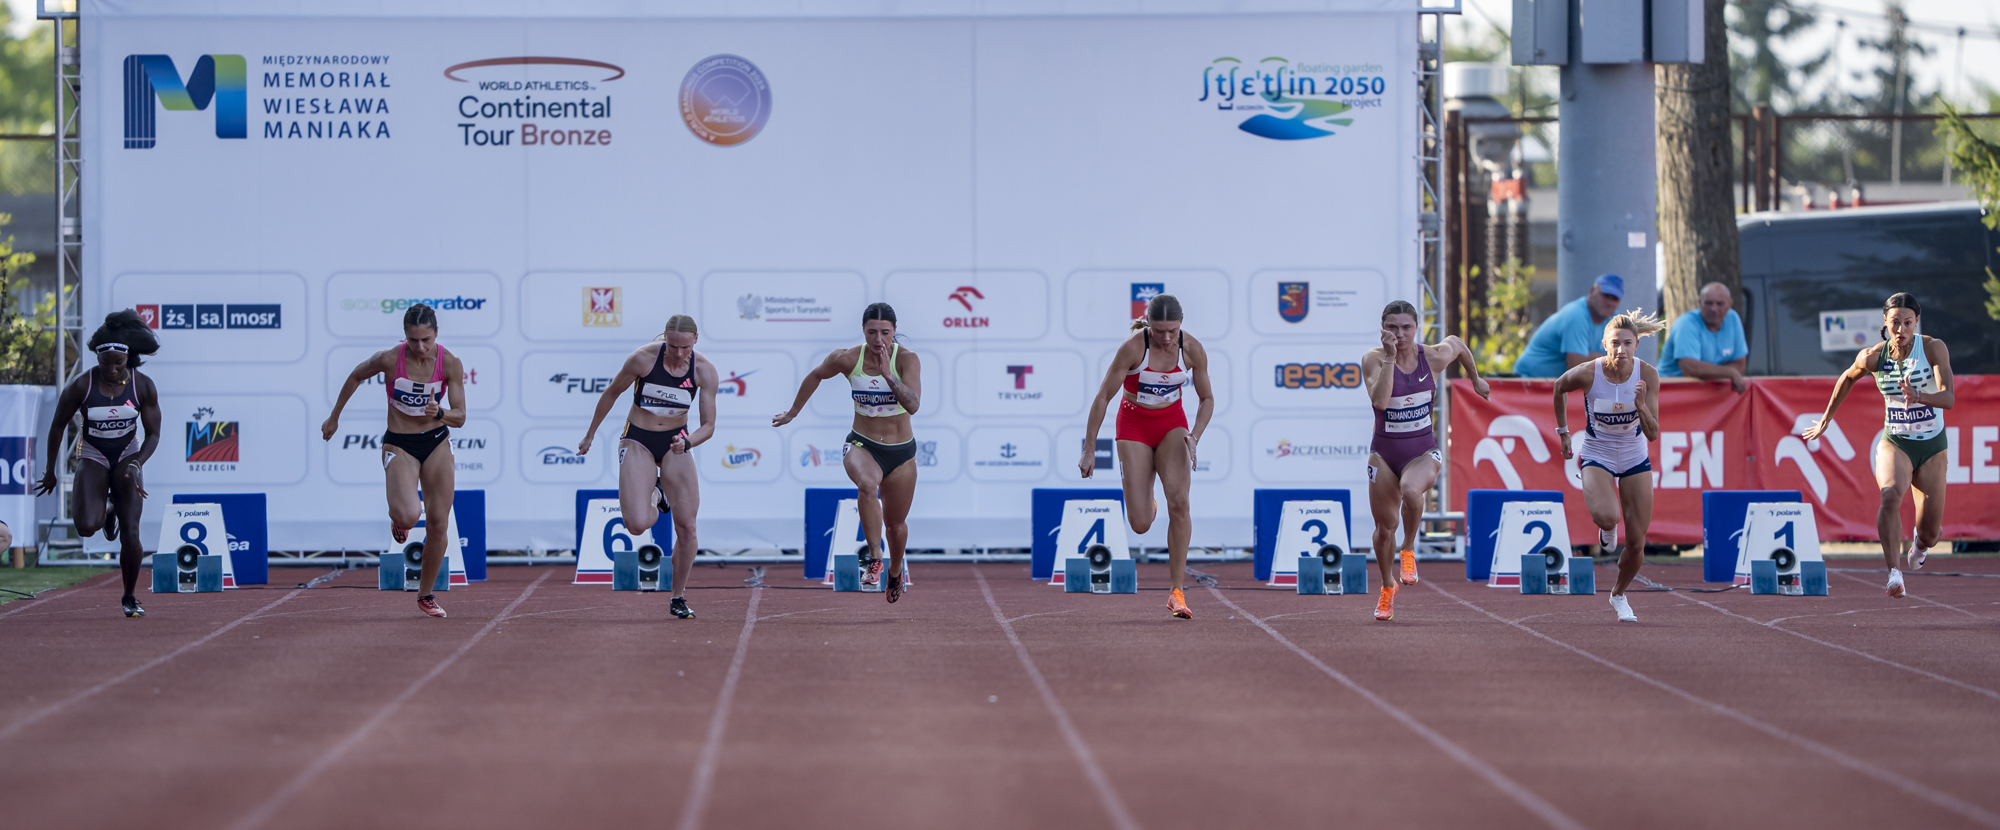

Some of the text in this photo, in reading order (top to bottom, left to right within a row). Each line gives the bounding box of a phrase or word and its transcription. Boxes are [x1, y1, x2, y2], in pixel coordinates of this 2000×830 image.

[262, 55, 391, 67] MIĘDZYNARODOWY
[1341, 63, 1383, 77] garden
[263, 72, 391, 88] MEMORIAŁ
[479, 81, 523, 91] WORLD
[1324, 76, 1385, 96] 2050
[263, 98, 390, 114] WIESŁAWA
[458, 95, 612, 119] Continental
[1340, 97, 1382, 110] project
[264, 121, 391, 139] MANIAKA
[457, 123, 613, 146] Tour Bronze
[943, 316, 990, 328] ORLEN
[1284, 364, 1361, 388] eska
[576, 378, 614, 394] FUE
[401, 394, 432, 405] CSÓT
[997, 392, 1043, 401] TRYUMF
[1387, 405, 1431, 420] TSIMANOUSKAYA
[1890, 408, 1934, 421] HEMIDA
[342, 434, 388, 450] PK
[543, 453, 586, 466] Enea
[189, 464, 237, 472] SZCZECIN
[184, 510, 211, 518] polanik
[1775, 509, 1802, 517] polanik
[603, 517, 634, 563] 6
[1077, 518, 1110, 554] 4
[1301, 519, 1328, 558] 3
[1522, 520, 1552, 555] 2
[1774, 521, 1795, 551] 1
